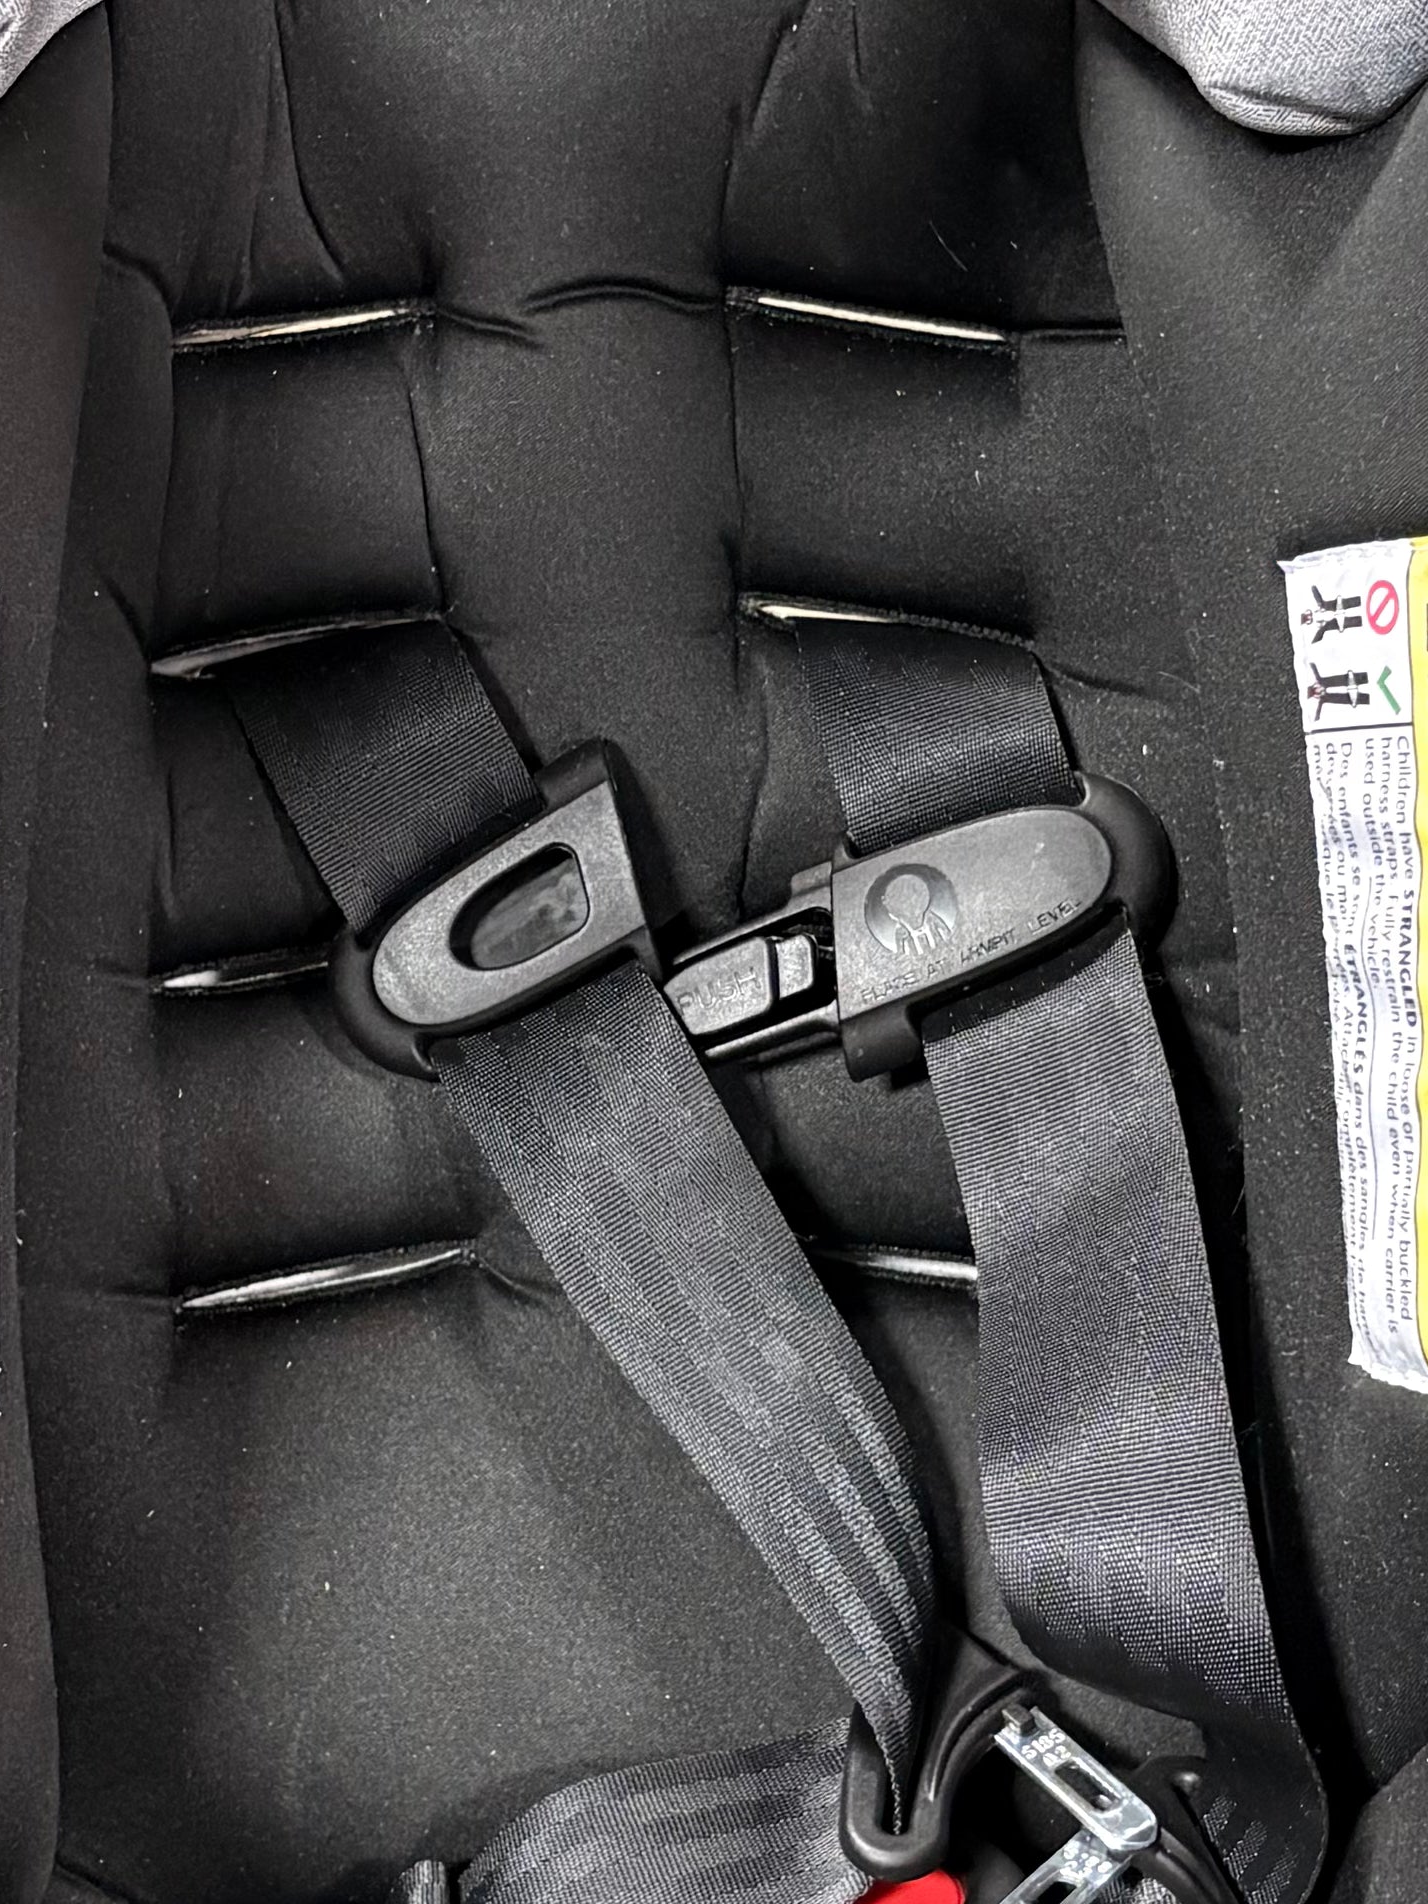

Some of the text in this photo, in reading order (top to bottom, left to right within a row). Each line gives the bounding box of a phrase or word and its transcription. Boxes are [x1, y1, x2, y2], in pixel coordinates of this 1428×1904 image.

[1379, 737, 1392, 813] harness
[1396, 736, 1411, 824] Children
[1338, 787, 1358, 858] enfants
[1363, 738, 1385, 988] used outside the vehicle.
[1399, 832, 1413, 879] have
[1382, 950, 1401, 1022] restrain
[1398, 890, 1417, 1027] STRANGLED
[1392, 1032, 1403, 1063] the
[1407, 1037, 1417, 1053] in
[1387, 1072, 1398, 1120] child
[1389, 1128, 1400, 1175] even
[1402, 1122, 1413, 1142] or
[1388, 1184, 1398, 1239] when
[1386, 1248, 1395, 1312] carrier
[1400, 1240, 1412, 1320] buckled
[1388, 1320, 1398, 1333] is
